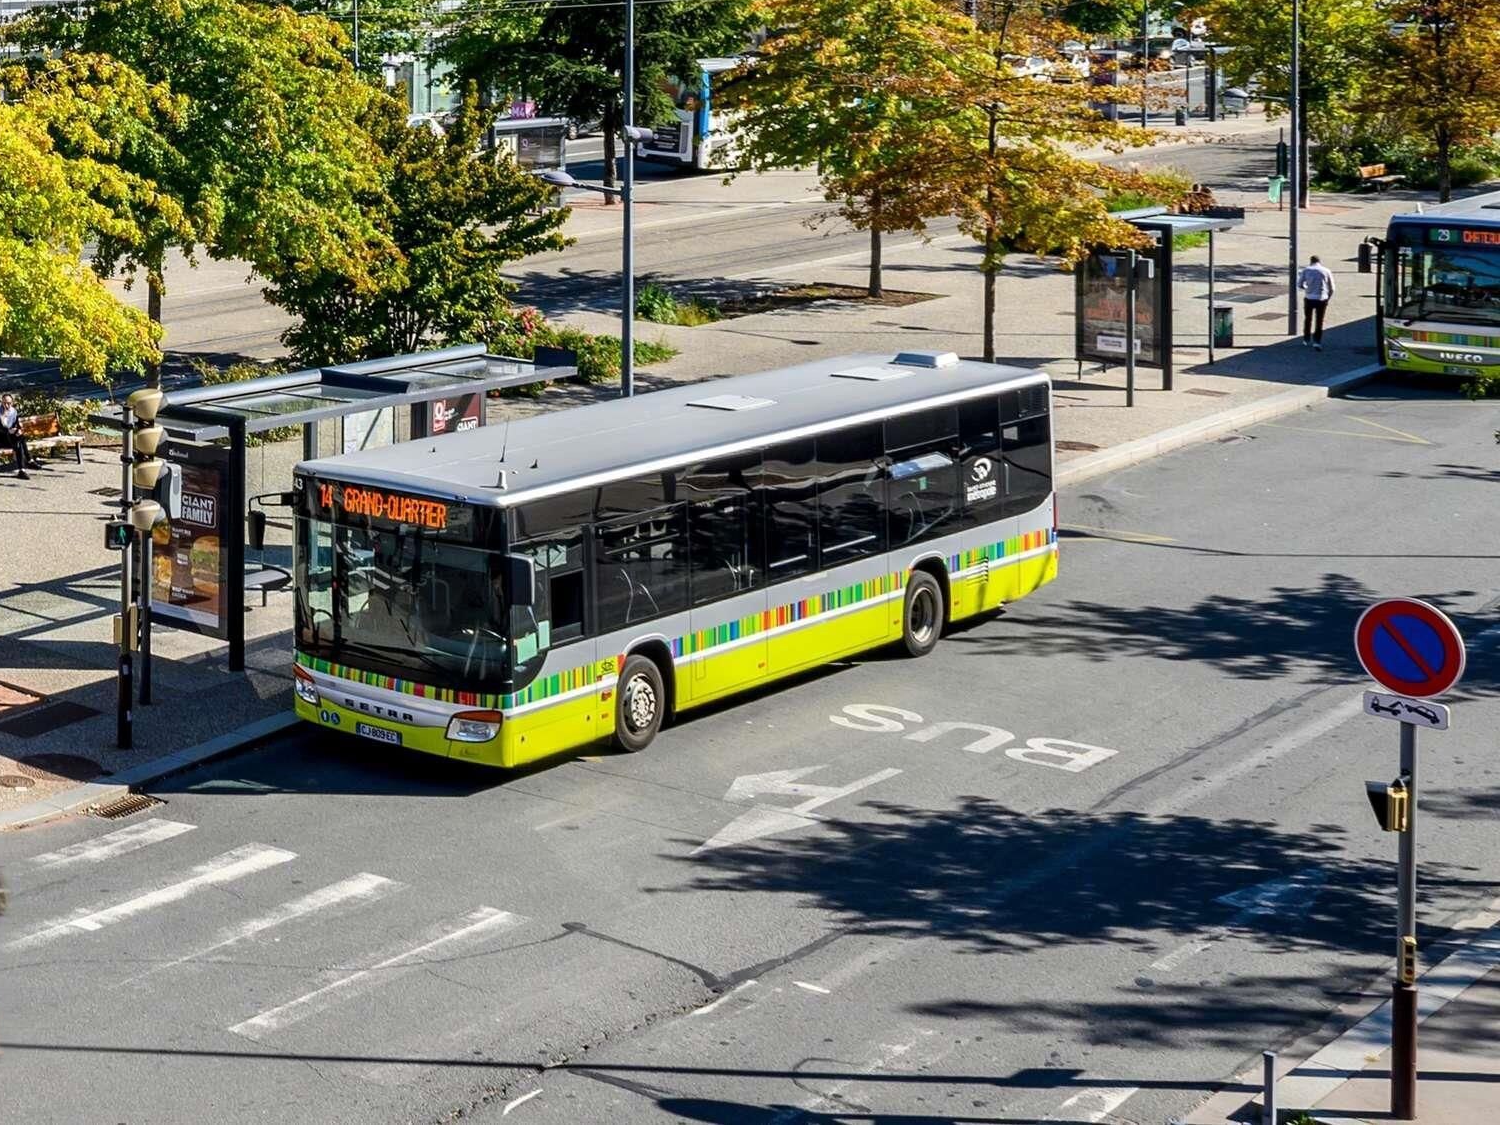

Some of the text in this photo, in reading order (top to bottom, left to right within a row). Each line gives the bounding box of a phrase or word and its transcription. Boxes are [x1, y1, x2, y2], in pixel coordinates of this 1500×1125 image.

[1440, 352, 1483, 363] IVECO
[182, 494, 214, 511] GIANT
[319, 483, 334, 508] 14
[343, 486, 447, 529] GRAND-QUARTIER
[182, 506, 214, 525] FAMILY
[344, 698, 414, 722] SETRA
[828, 703, 1120, 774] BUS
